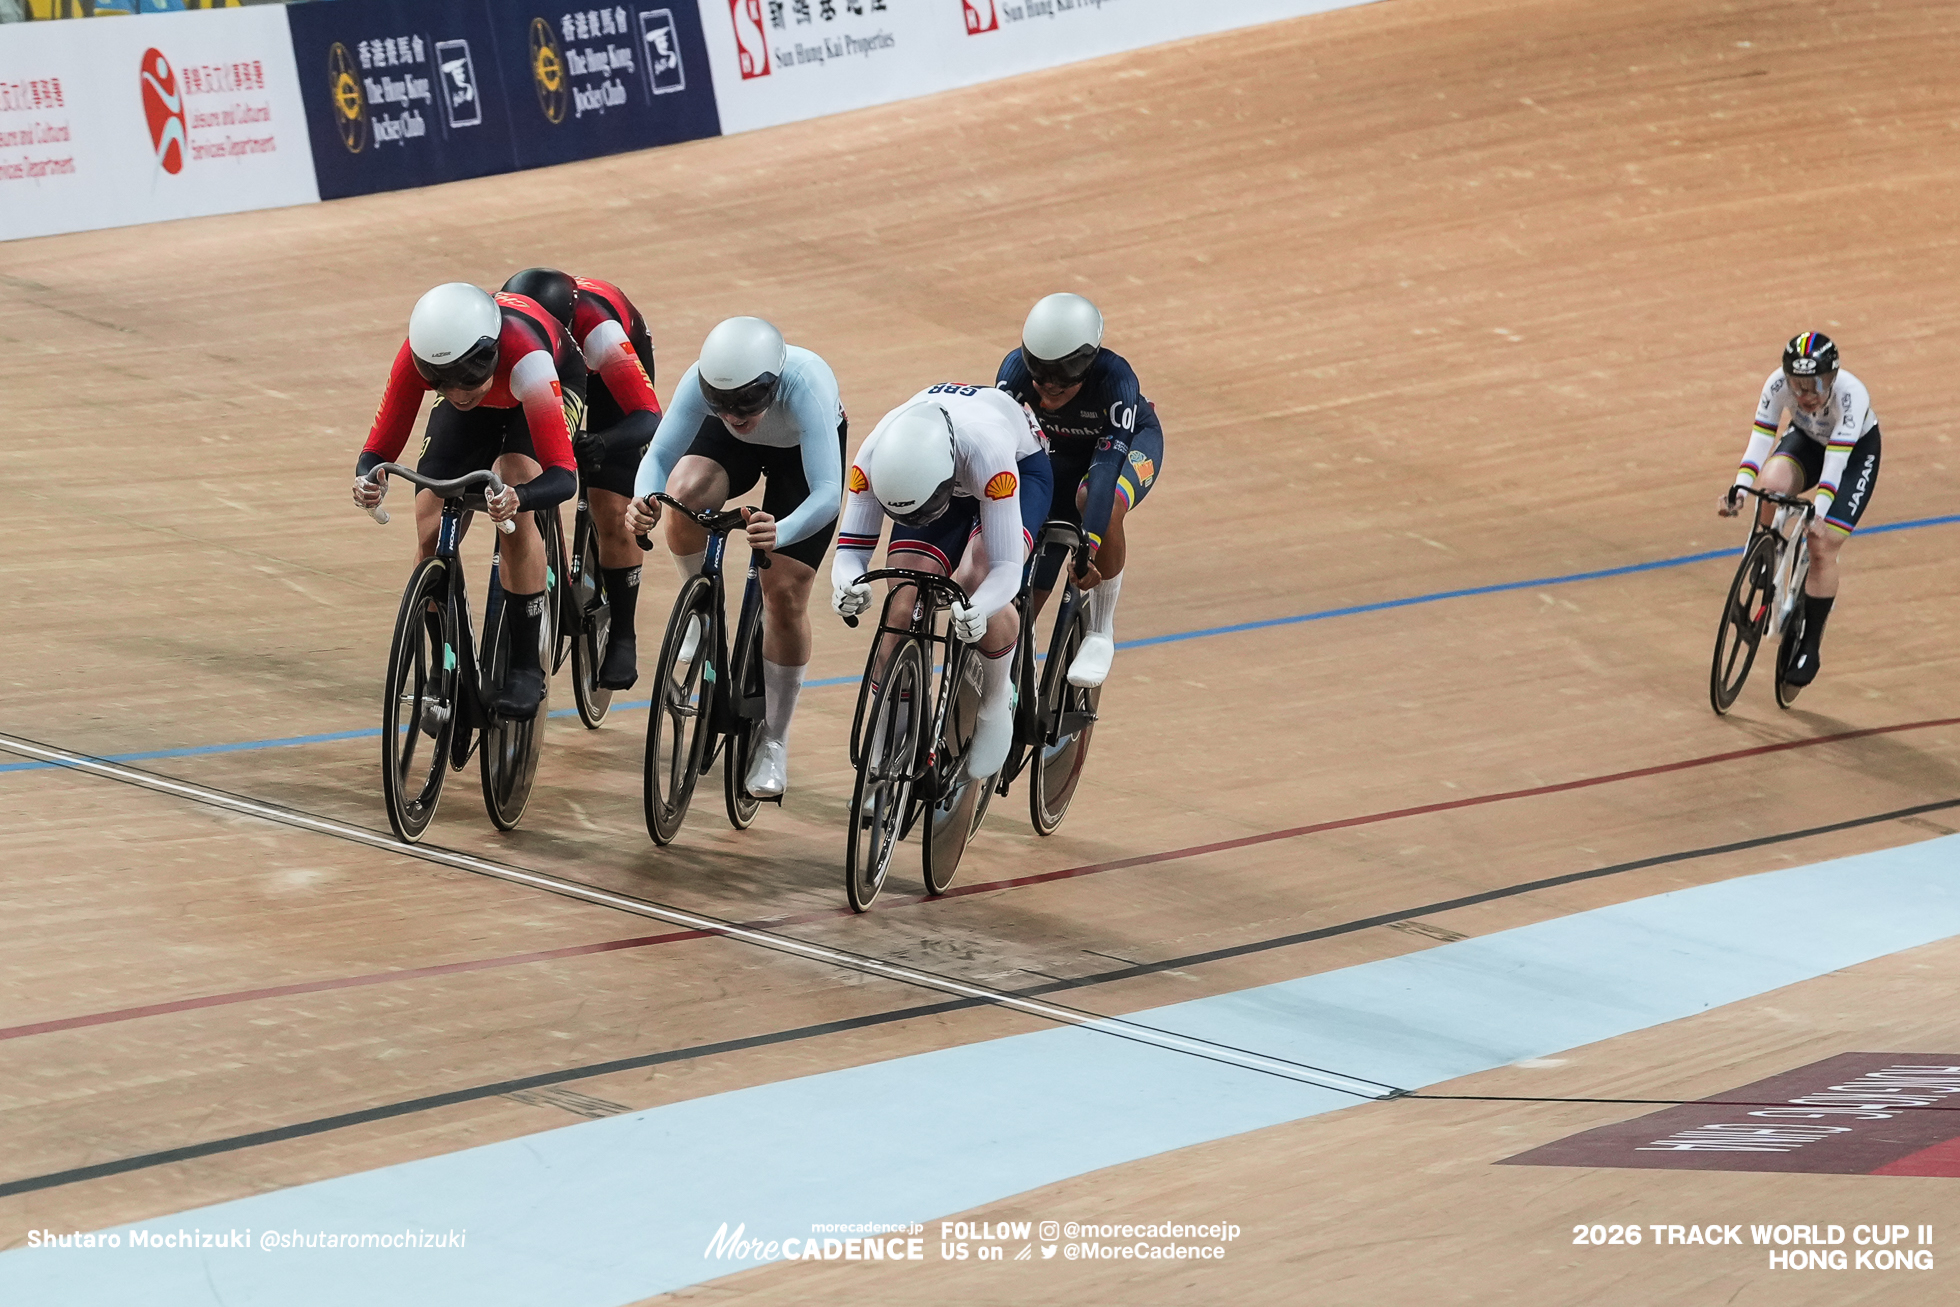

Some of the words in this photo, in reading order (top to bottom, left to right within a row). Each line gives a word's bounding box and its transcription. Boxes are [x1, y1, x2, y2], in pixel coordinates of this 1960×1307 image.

[565, 48, 588, 76] The
[584, 47, 611, 78] Hong
[607, 43, 635, 74] Kong
[775, 48, 795, 69] Sun
[795, 43, 825, 66] Hung
[824, 36, 845, 59] Kai
[844, 28, 896, 57] Properties
[364, 77, 385, 104] The
[381, 76, 409, 108] Hong
[404, 73, 432, 106] Kong
[572, 82, 605, 119] Jockey
[601, 78, 627, 107] Club
[371, 112, 404, 150] Jockey
[401, 109, 426, 139] Club
[1847, 454, 1875, 516] JAPAN
[887, 499, 916, 507] LAZER
[449, 517, 458, 551] KOGA
[714, 537, 724, 569] KOGA
[1634, 1123, 1853, 1152] CHINA
